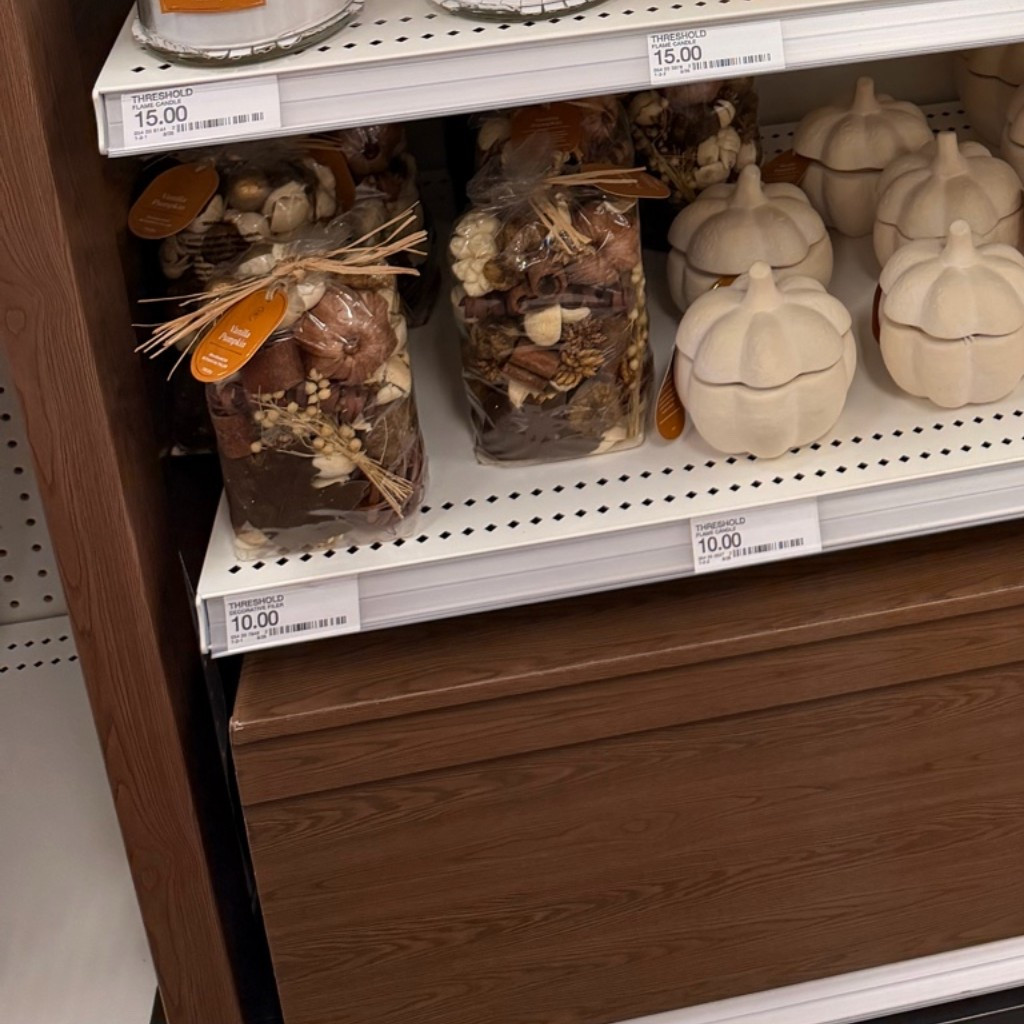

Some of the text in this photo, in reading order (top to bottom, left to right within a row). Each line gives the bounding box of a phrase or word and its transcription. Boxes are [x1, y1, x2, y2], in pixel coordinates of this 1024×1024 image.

[651, 30, 706, 43] THRESHOLD
[654, 45, 702, 65] 15.00
[132, 88, 193, 104] THRESHOLD
[132, 99, 181, 110] FLAME CANDLE
[135, 105, 188, 127] 15.00
[230, 324, 251, 338] Vanilla
[218, 332, 247, 348] Pumpkin
[696, 517, 746, 532] THRESHOLD
[699, 532, 742, 553] 10.00
[228, 595, 284, 609] THRESHOLD
[232, 610, 279, 632] 10.00
